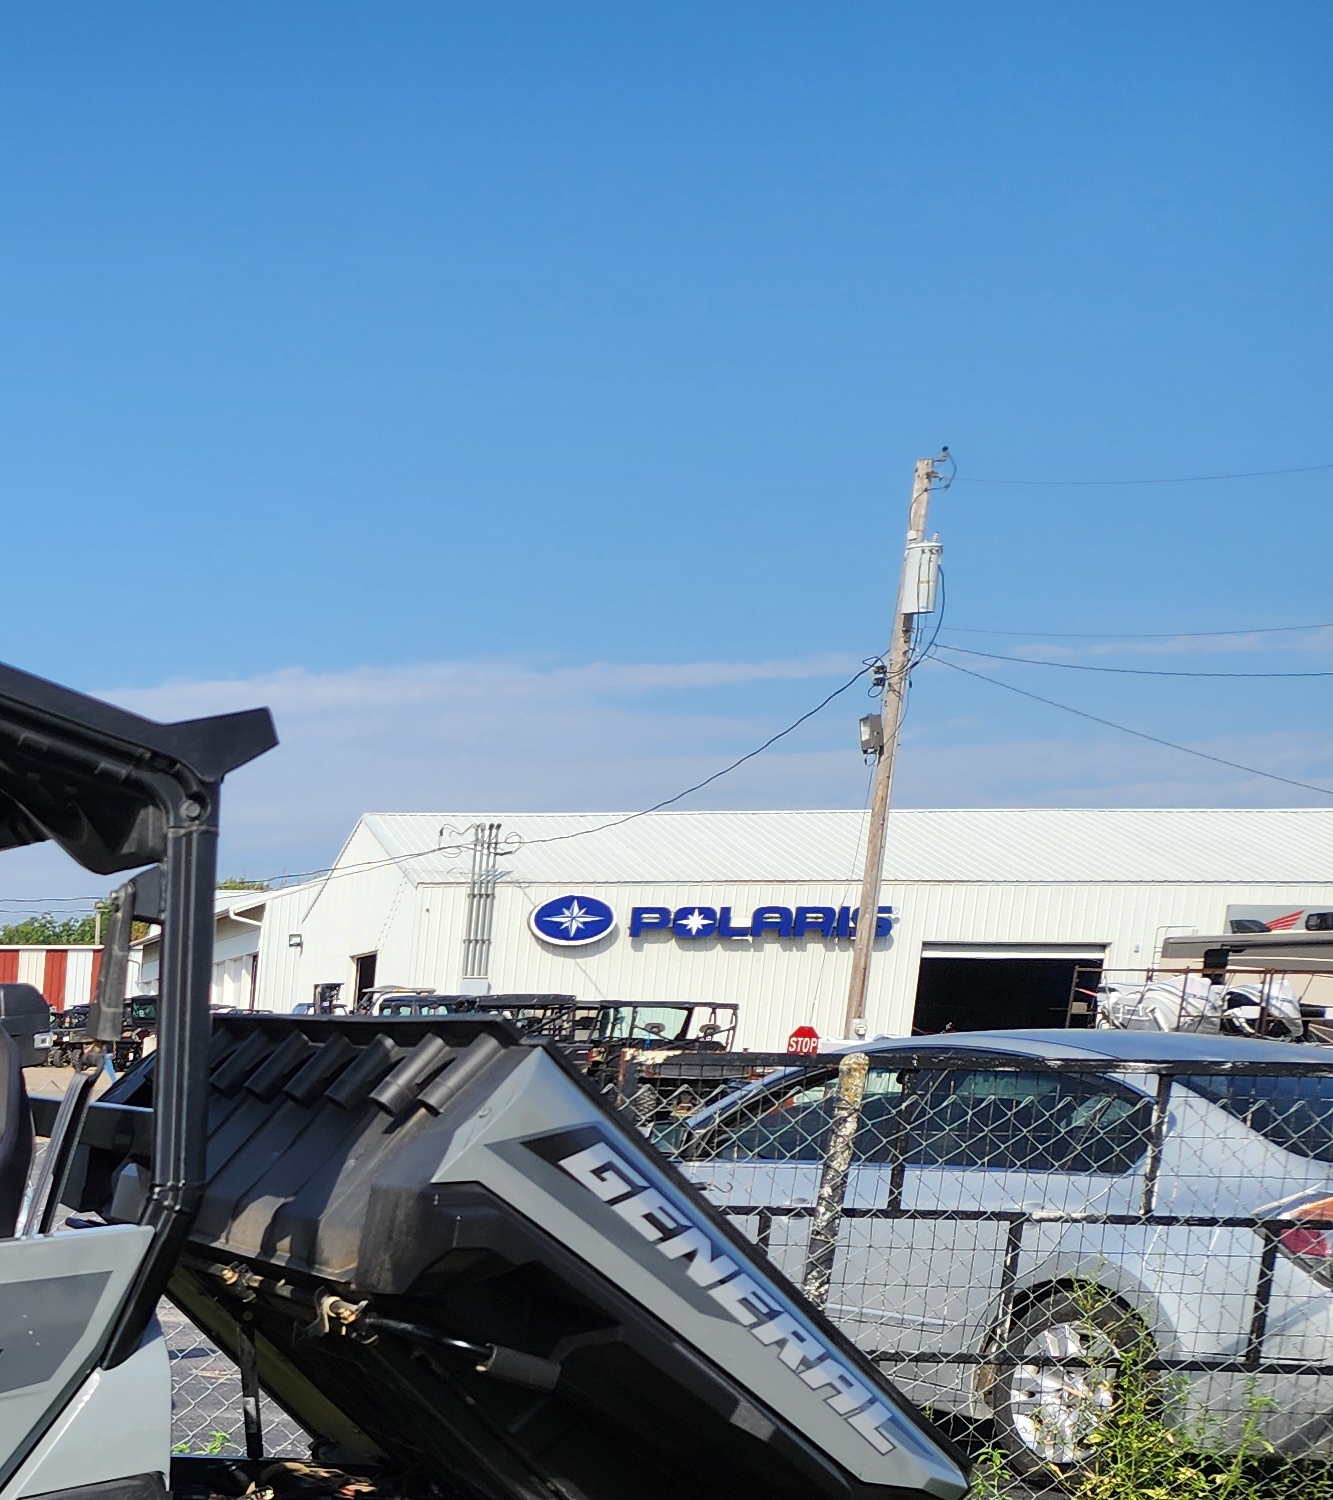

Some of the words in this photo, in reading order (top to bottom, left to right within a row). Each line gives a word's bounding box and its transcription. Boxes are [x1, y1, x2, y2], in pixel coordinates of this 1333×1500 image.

[629, 906, 894, 938] POLARIS
[789, 1037, 818, 1052] STOP
[558, 1141, 898, 1457] GENERAL
